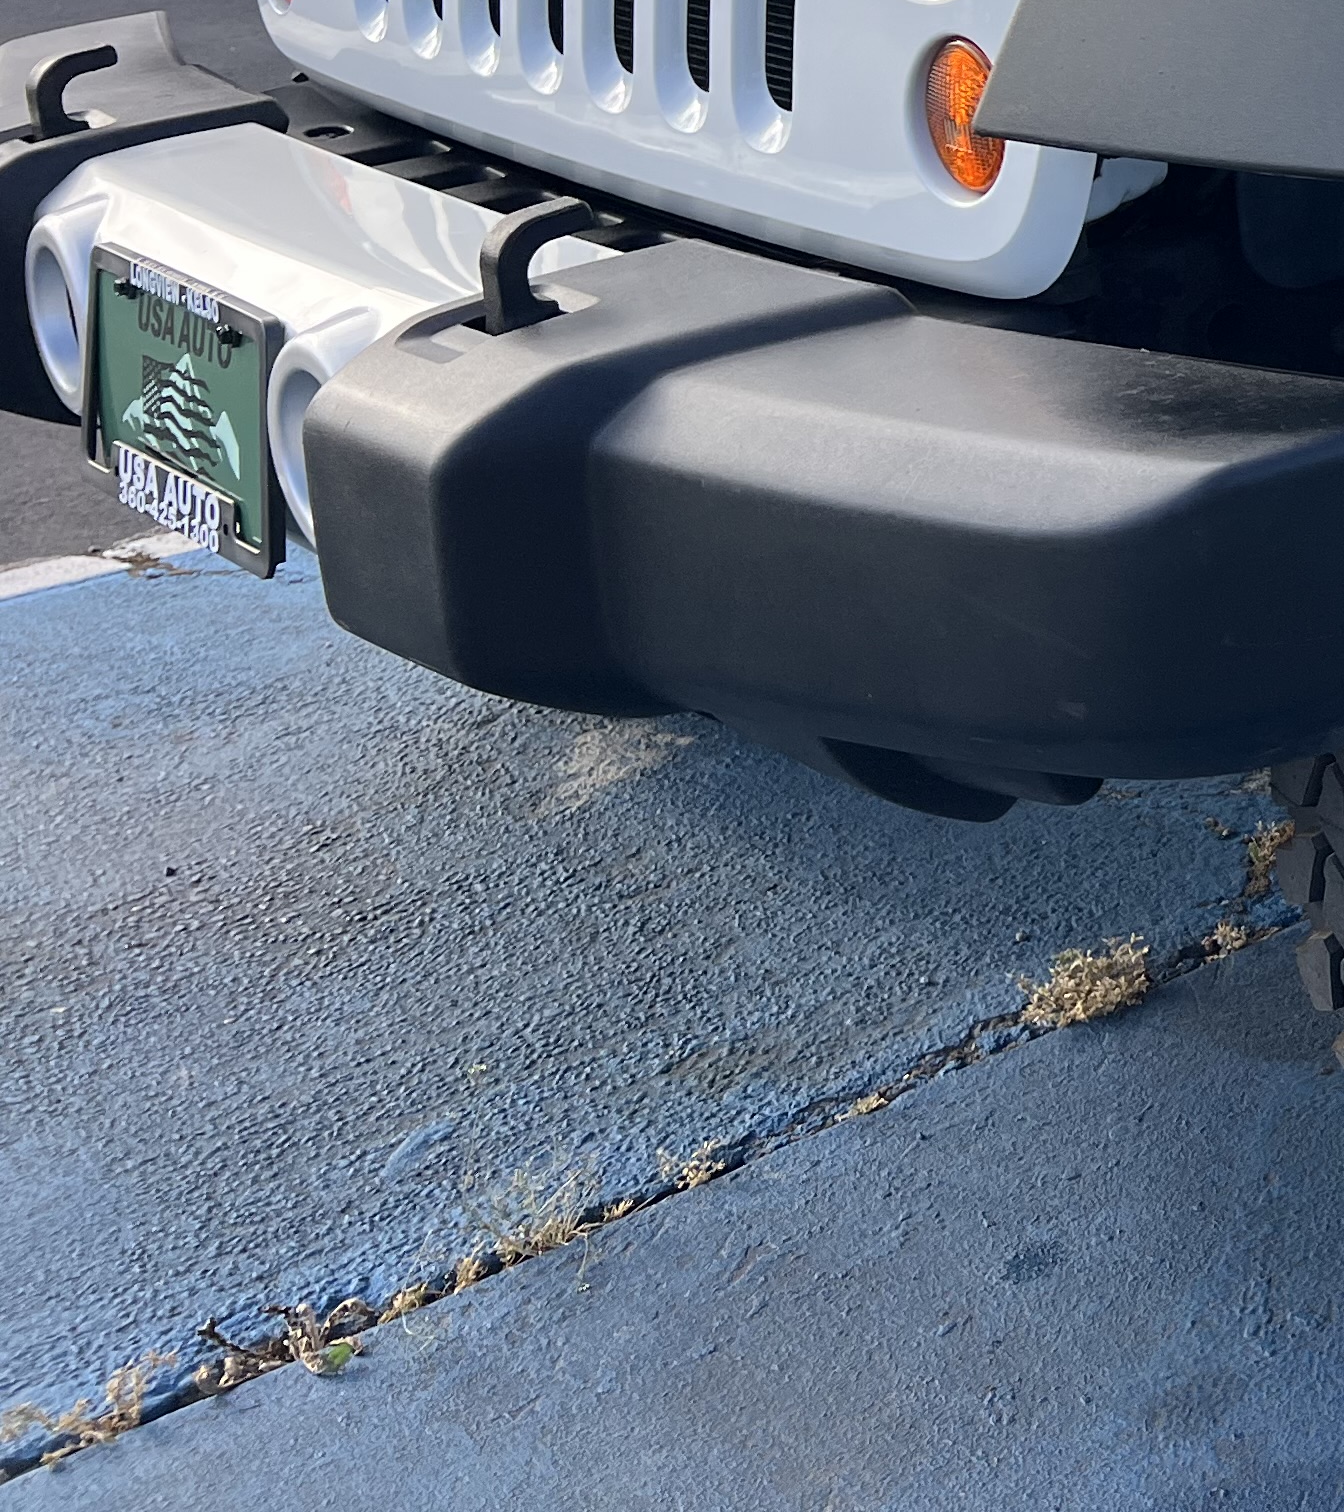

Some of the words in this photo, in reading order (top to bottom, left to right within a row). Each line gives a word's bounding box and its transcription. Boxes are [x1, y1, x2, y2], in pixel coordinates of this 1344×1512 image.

[138, 294, 175, 346] USA
[177, 310, 233, 369] AUTO
[119, 448, 158, 500] USA
[163, 472, 220, 530] AUTO
[119, 481, 219, 553] 360-425-1300
